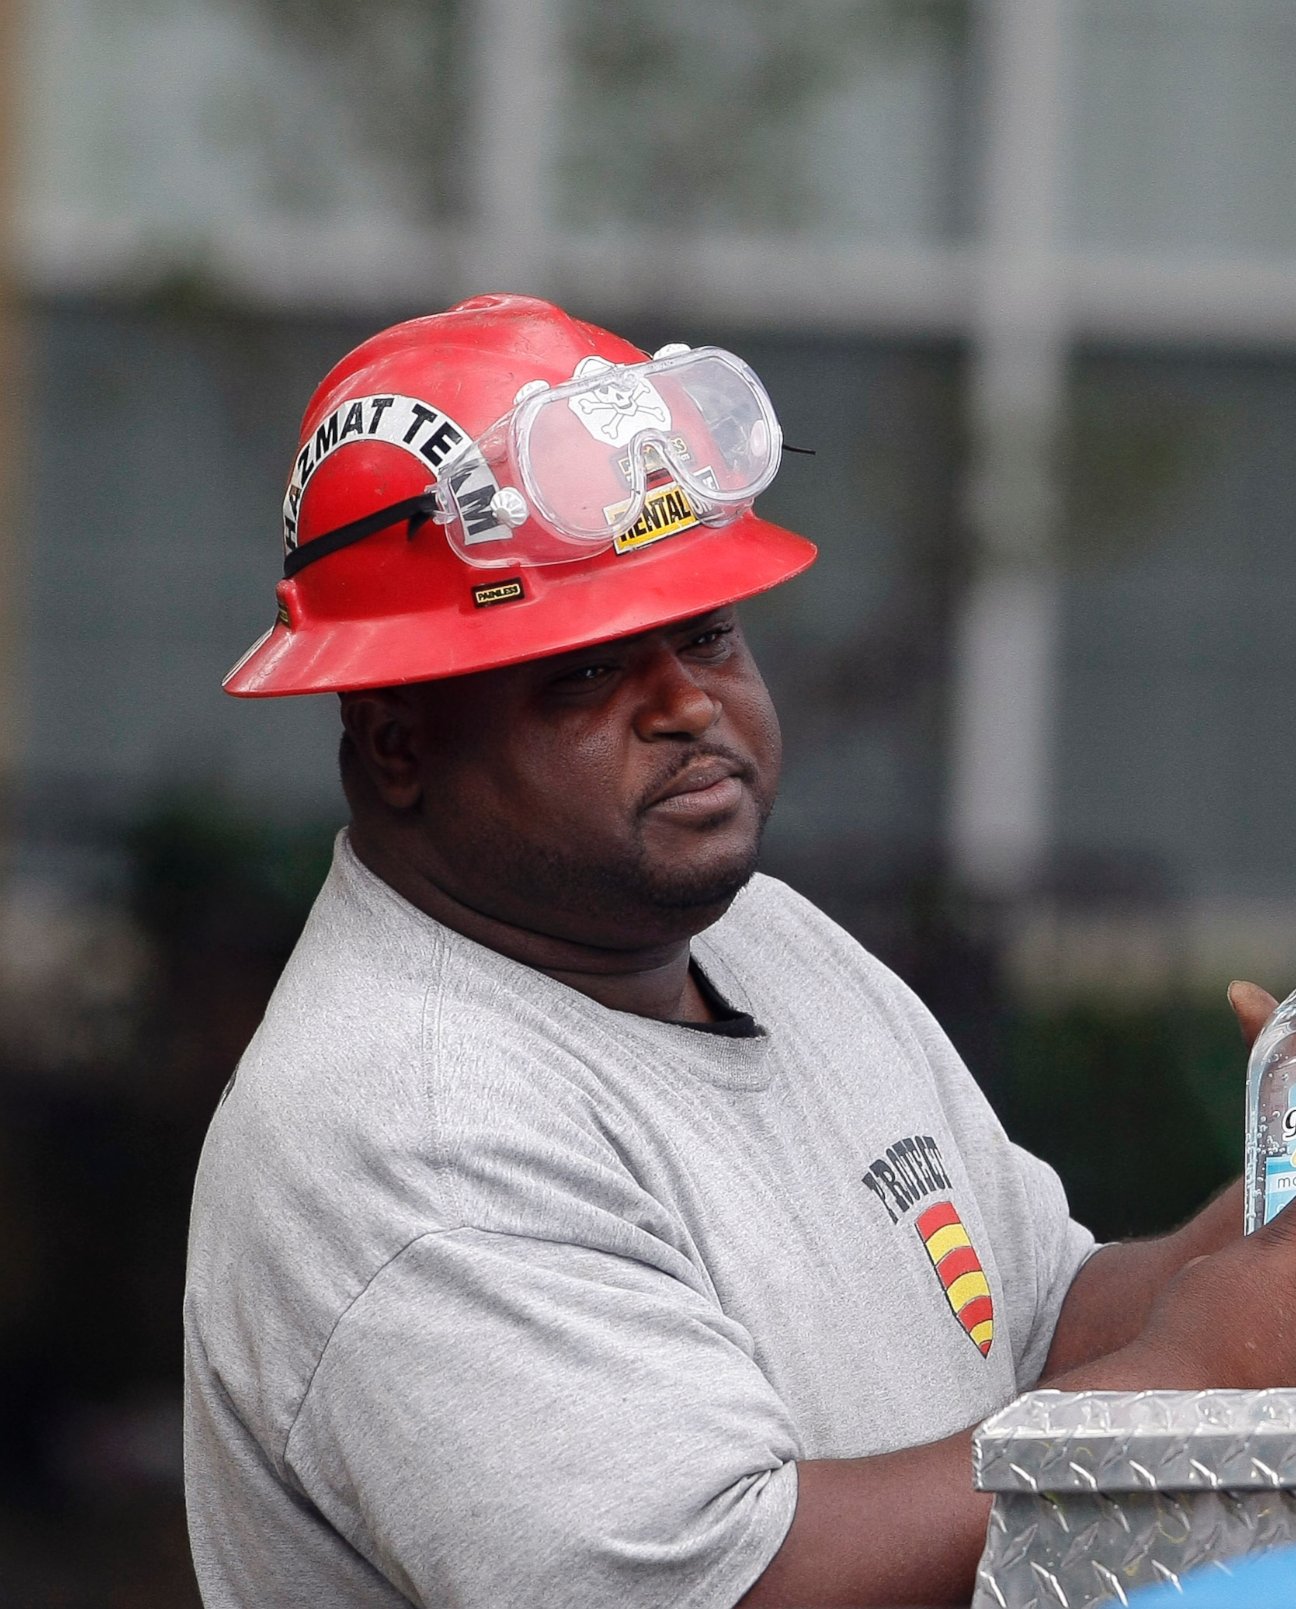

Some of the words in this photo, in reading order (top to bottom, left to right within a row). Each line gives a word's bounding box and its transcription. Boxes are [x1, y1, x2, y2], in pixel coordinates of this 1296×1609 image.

[283, 397, 395, 552] HAZMAT
[402, 403, 502, 536] TEAM
[477, 585, 519, 601] PAINLESS
[861, 1135, 953, 1225] PROTECT
